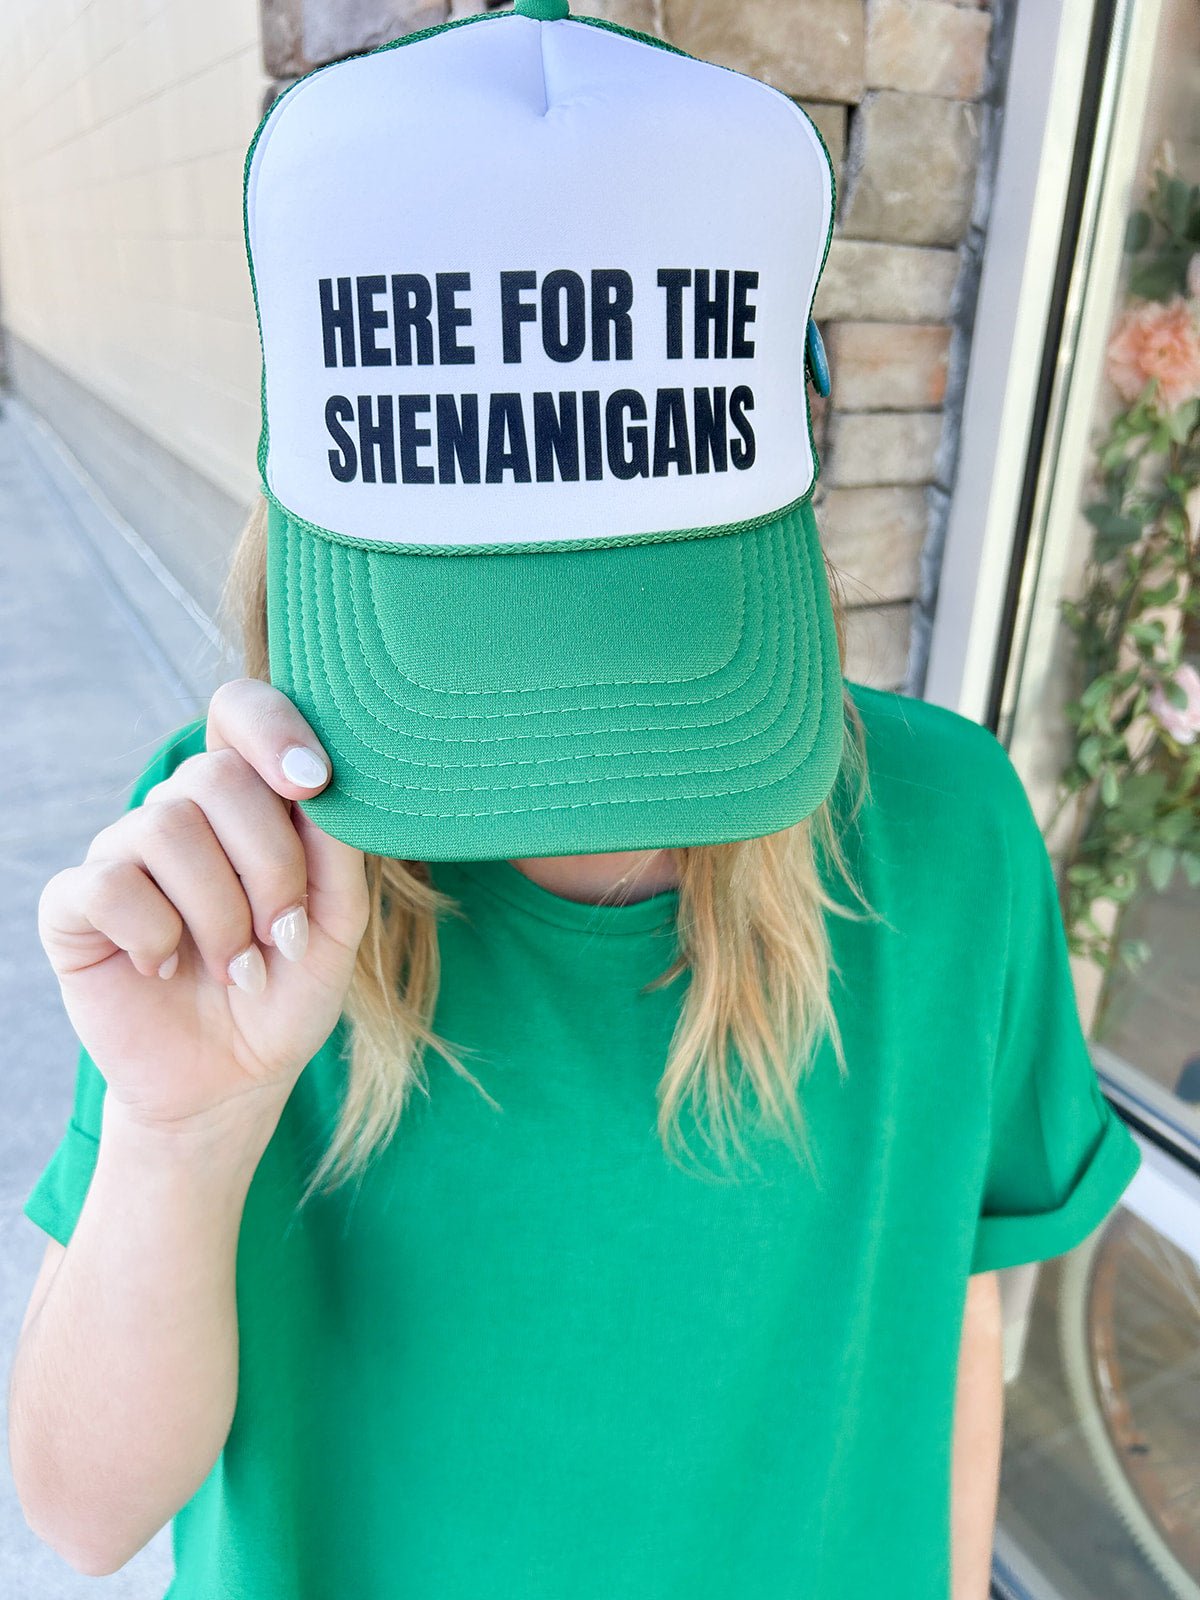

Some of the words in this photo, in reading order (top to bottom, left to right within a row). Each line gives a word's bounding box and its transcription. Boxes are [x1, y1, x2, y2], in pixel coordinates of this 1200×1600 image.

[319, 272, 476, 367] HERE
[501, 269, 633, 363] FOR
[657, 269, 759, 360] THE
[325, 385, 755, 484] SHENANIGANS
